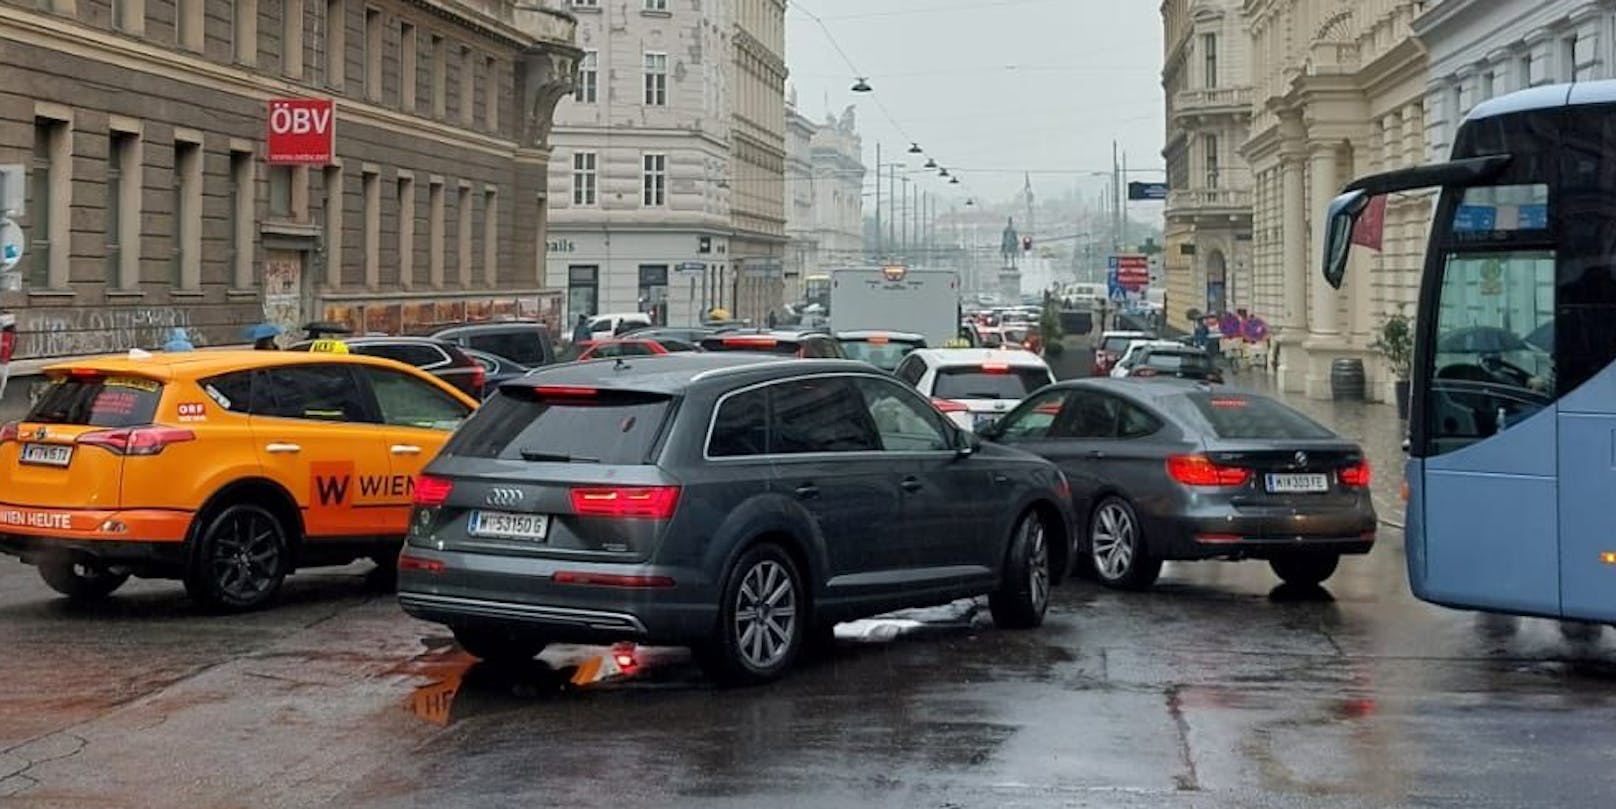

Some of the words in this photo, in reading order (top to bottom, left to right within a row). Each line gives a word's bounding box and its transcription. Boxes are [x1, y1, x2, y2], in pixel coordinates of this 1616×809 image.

[271, 102, 330, 134] ÖBV
[179, 404, 204, 416] ORF
[316, 475, 350, 506] W
[27, 511, 72, 529] HEUTE
